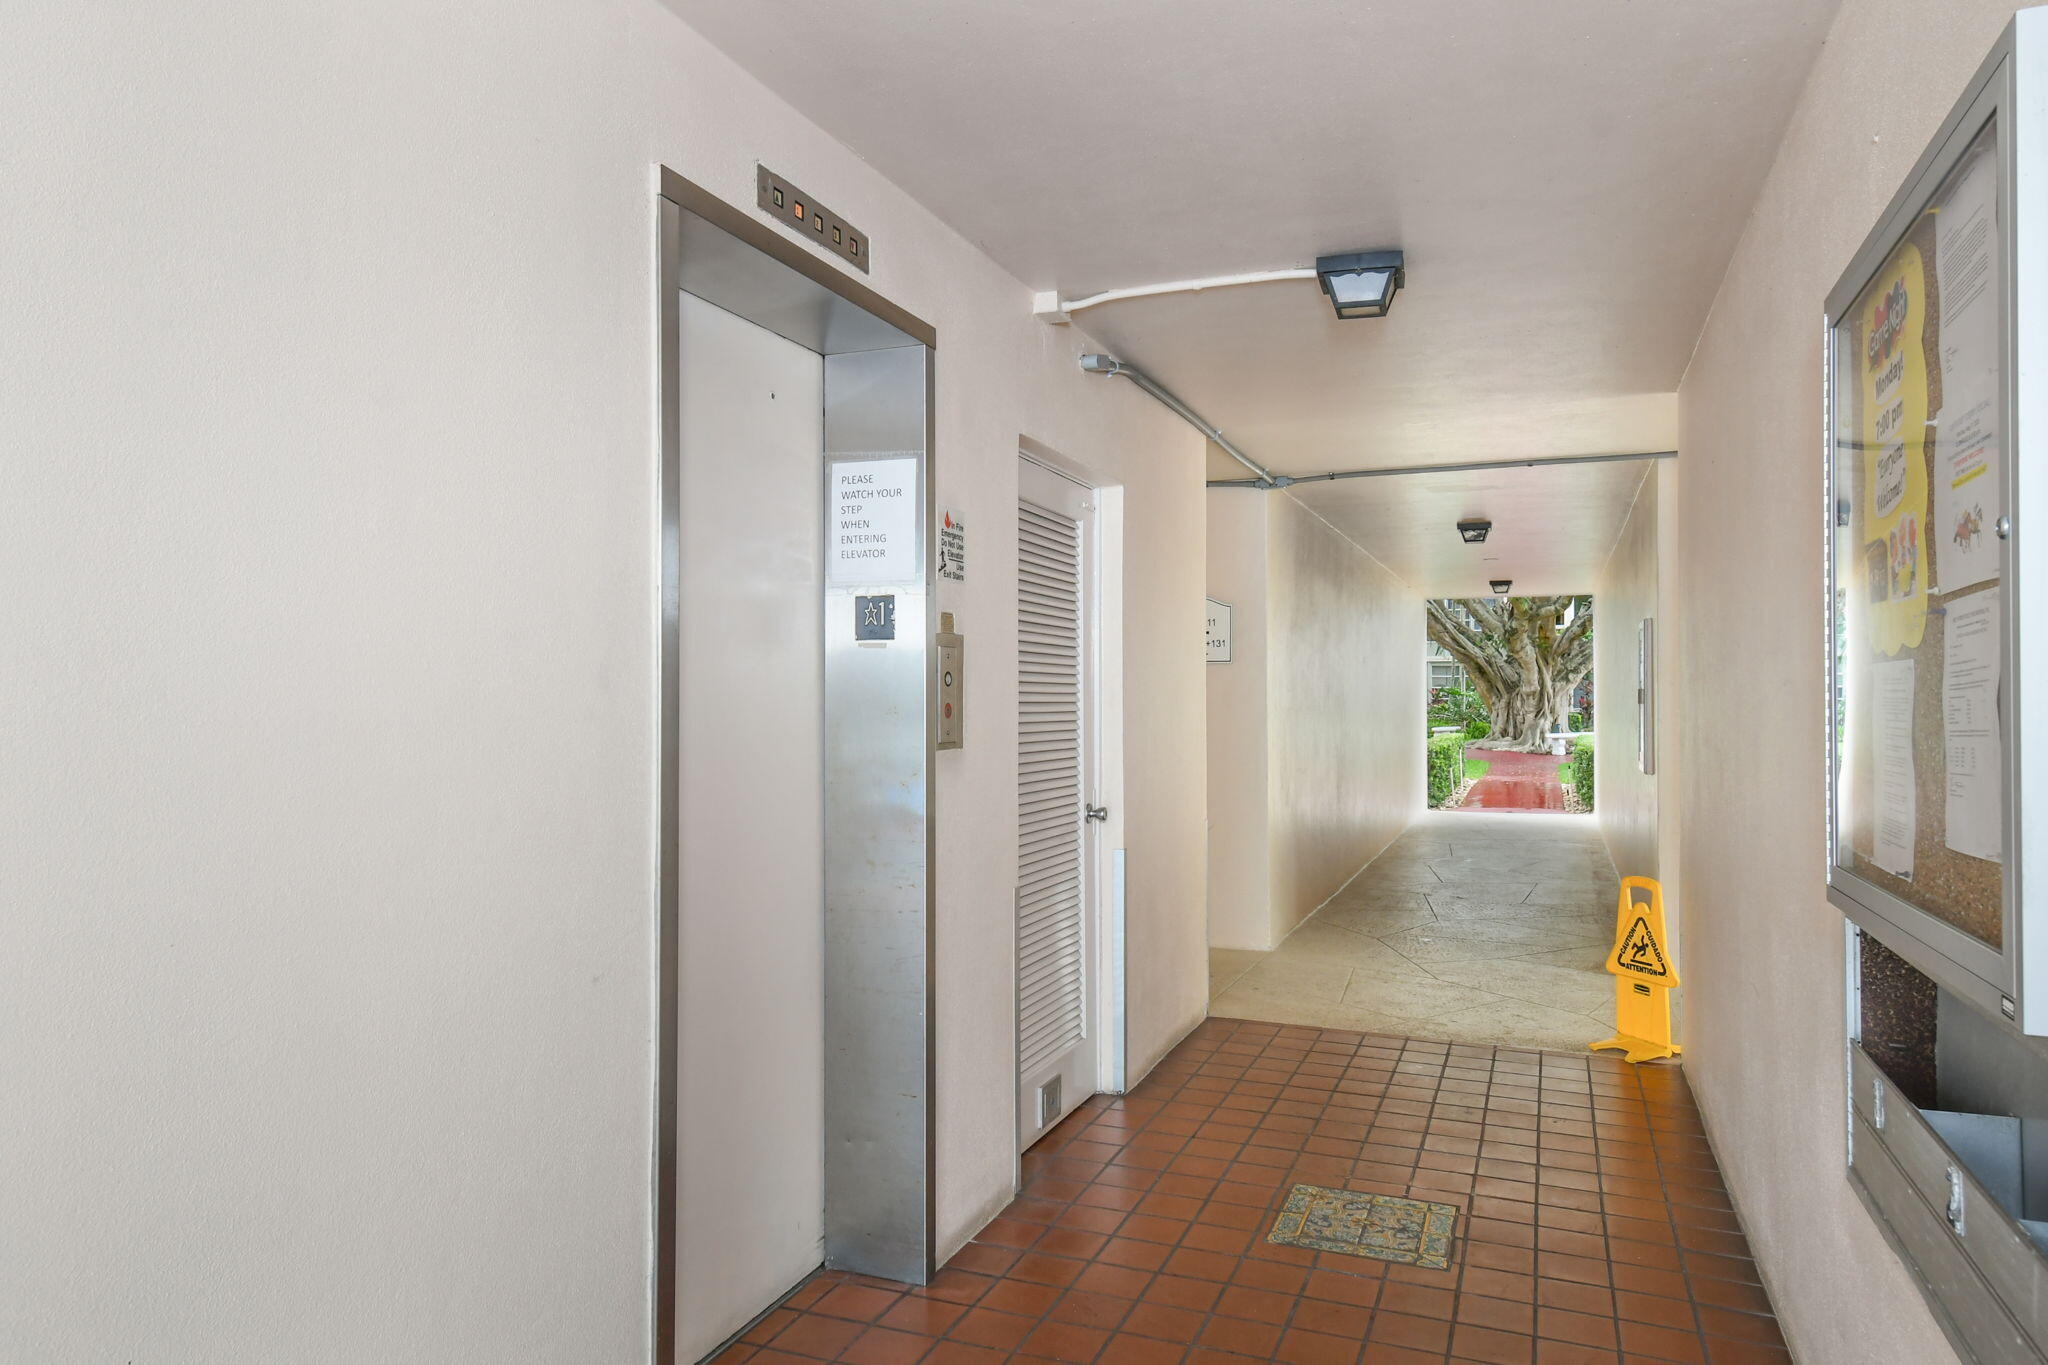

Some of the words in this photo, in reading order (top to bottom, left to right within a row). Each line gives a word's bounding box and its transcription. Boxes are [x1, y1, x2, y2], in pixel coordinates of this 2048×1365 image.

[1876, 408, 1890, 440] 7:00
[1892, 400, 1903, 429] pm
[841, 474, 874, 485] PLEASE
[841, 489, 874, 499] WATCH
[876, 488, 902, 498] YOUR
[841, 505, 863, 515] STEP
[841, 519, 870, 529] WHEN
[956, 522, 964, 532] Fire
[841, 533, 887, 544] ENTERING
[941, 528, 964, 543] Emergency
[941, 538, 947, 547] Do
[948, 539, 956, 548] Not
[956, 541, 964, 551] Use
[841, 548, 886, 559] ELEVATOR
[947, 549, 964, 560] Elevator
[956, 563, 964, 571] Use
[944, 569, 952, 578] Exit
[952, 571, 964, 581] Stairs
[879, 601, 885, 626] 1
[1620, 926, 1637, 955] CAUTION
[1646, 930, 1663, 962] CUIDADO
[1624, 963, 1659, 977] ATTENTION
